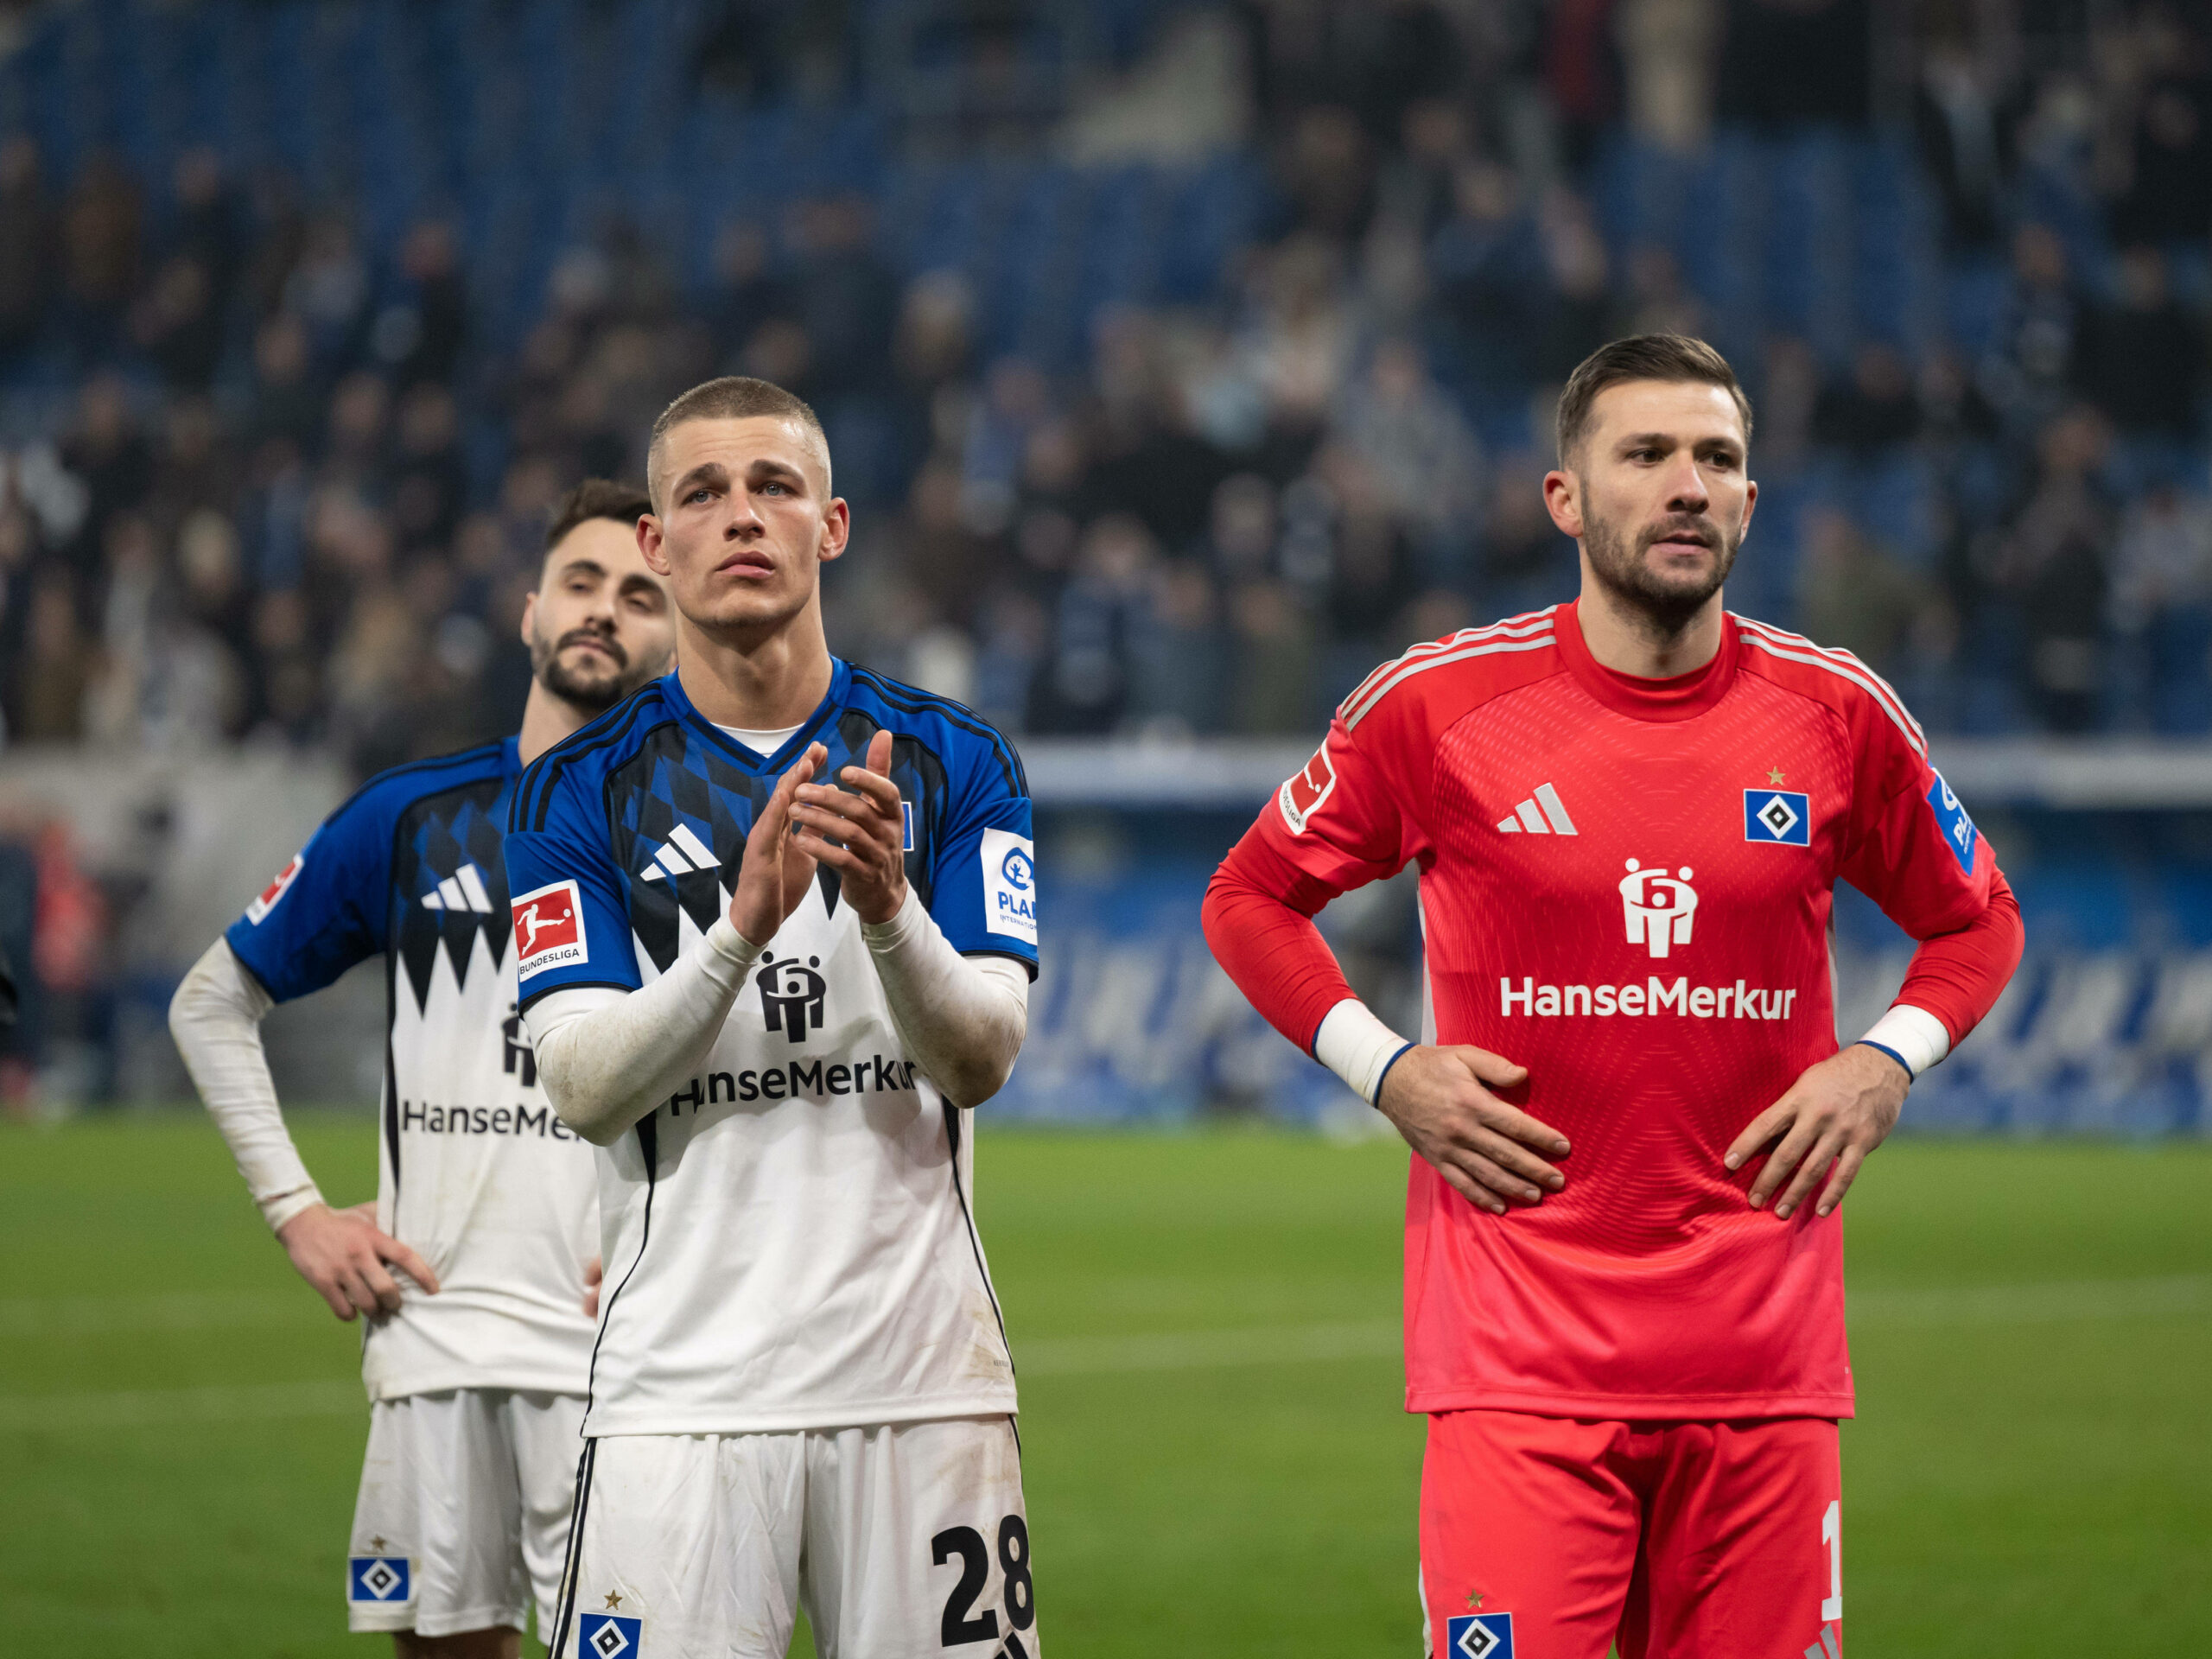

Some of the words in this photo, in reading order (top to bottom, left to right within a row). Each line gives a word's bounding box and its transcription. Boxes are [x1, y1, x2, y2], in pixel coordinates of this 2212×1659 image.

[519, 948, 580, 975] BUNDESLIGA
[1500, 976, 1797, 1020] HanseMerkur
[671, 1054, 917, 1116] HnseMerkur
[403, 1099, 582, 1142] HanseMe
[931, 1514, 1035, 1648] 28
[1821, 1499, 1843, 1622] 1
